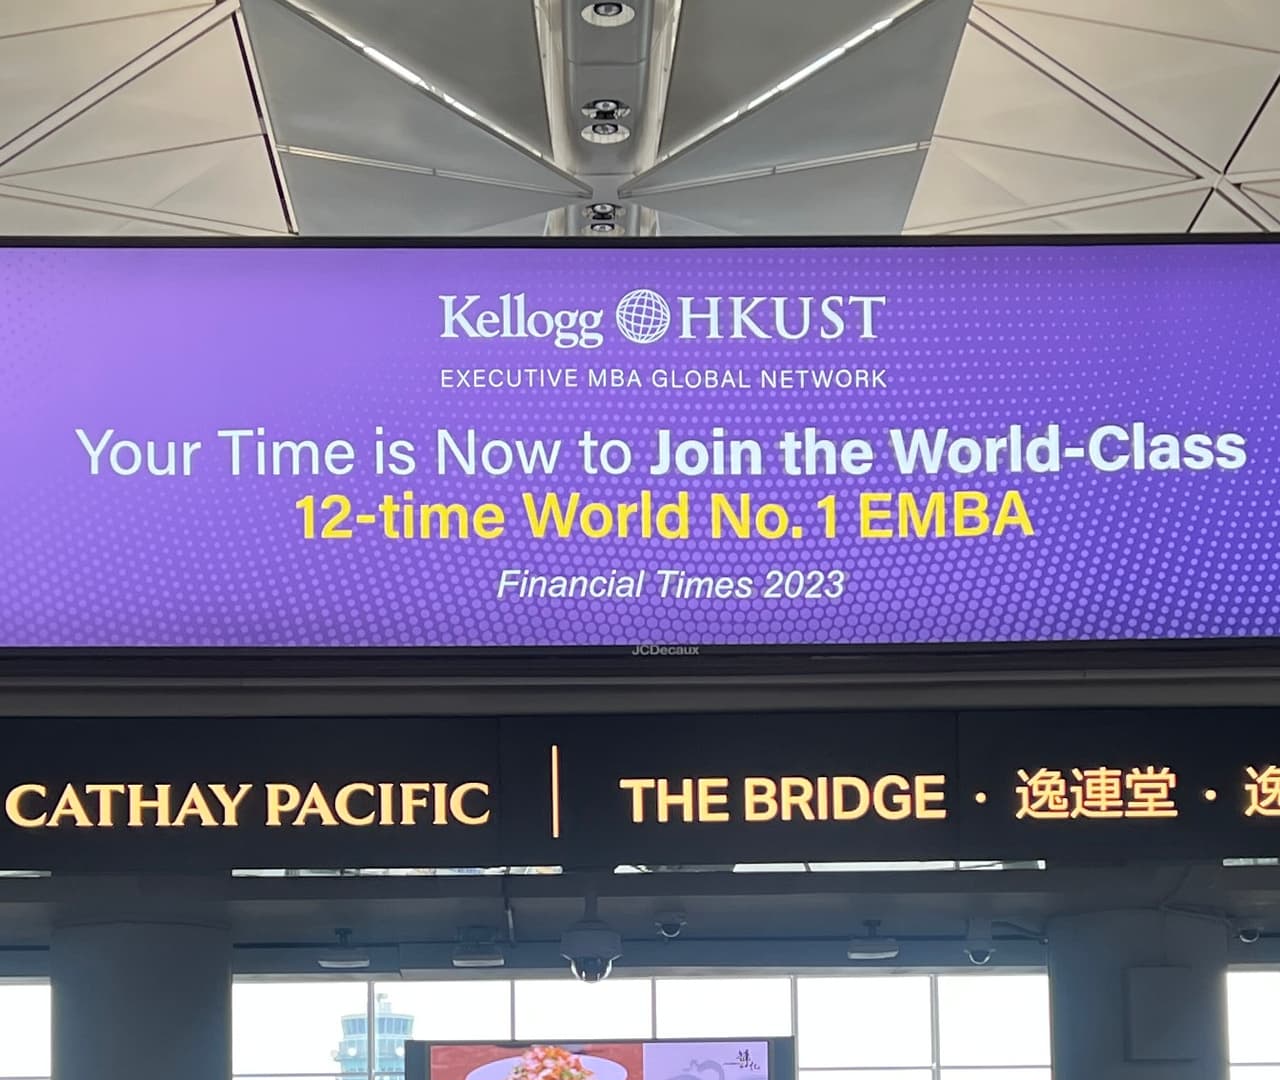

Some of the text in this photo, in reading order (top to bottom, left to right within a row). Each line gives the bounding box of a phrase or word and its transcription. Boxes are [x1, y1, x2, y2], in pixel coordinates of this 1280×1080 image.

[438, 292, 887, 349] Kellogg HKUST
[440, 369, 887, 388] EXECUTIVE MBA GLOBAL NETWORK
[75, 423, 1248, 476] Your Time is Now to Join the World-Class
[295, 490, 1035, 540] 12-time World No. 1 EMBA
[497, 569, 845, 599] Financial Times 2023
[632, 645, 700, 656] JCDecaux
[6, 782, 490, 828] CATHAY PACIFIC
[619, 775, 947, 823] THE BRIDGE
[1015, 766, 1179, 820] 逸連堂
